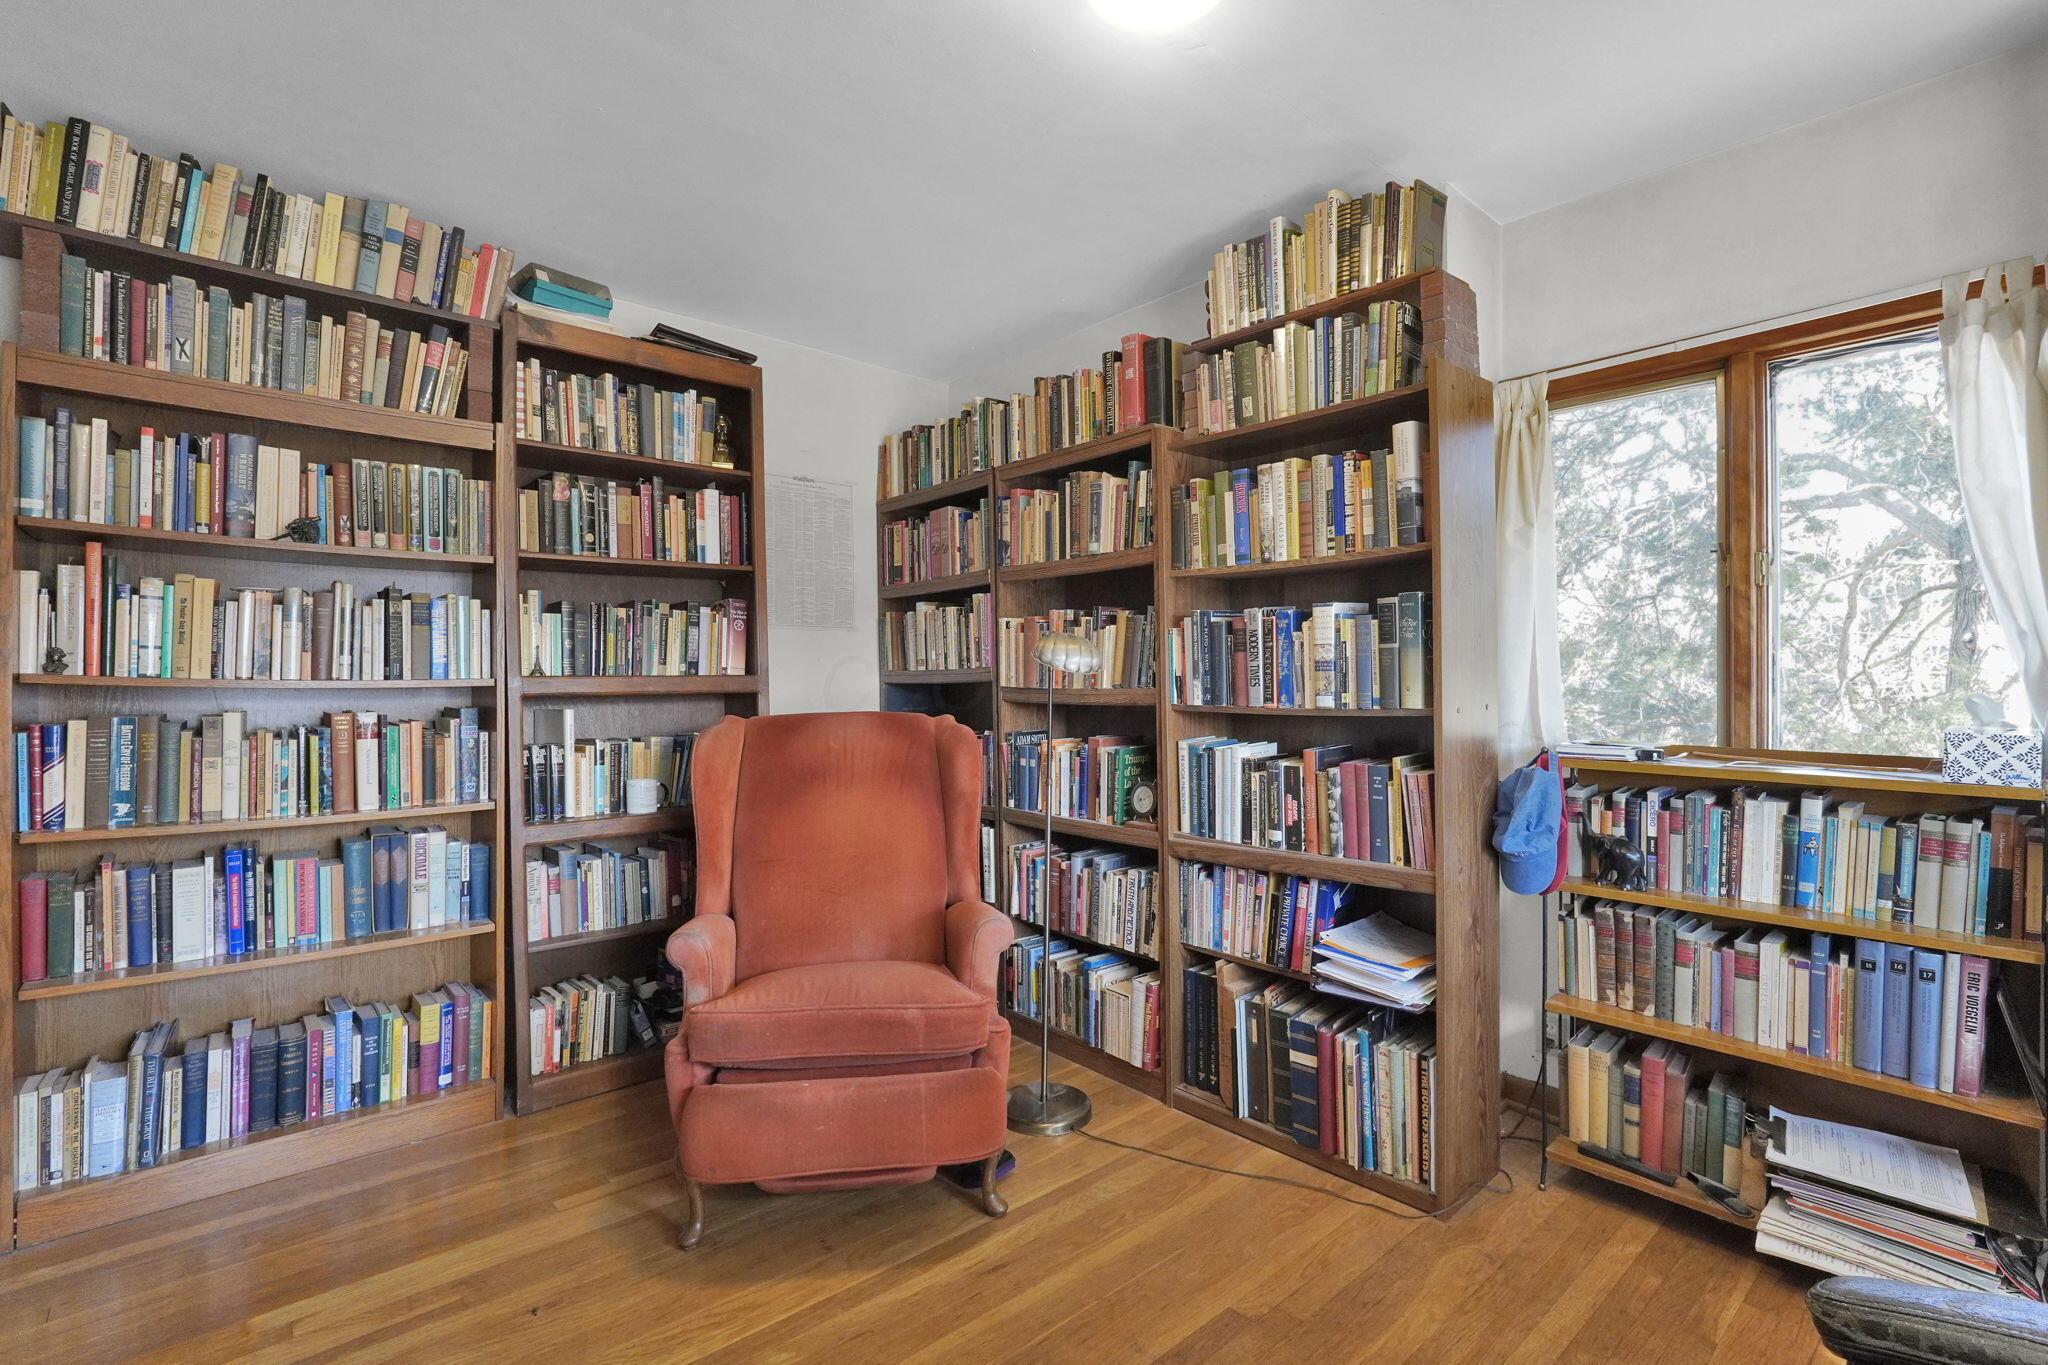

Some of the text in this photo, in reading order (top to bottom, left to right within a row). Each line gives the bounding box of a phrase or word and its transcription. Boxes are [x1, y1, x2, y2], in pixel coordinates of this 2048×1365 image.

[73, 122, 82, 136] THE
[70, 136, 80, 152] BOOK
[69, 152, 77, 160] OF
[66, 161, 75, 185] ABIGAIL
[64, 186, 73, 199] AND
[61, 198, 71, 217] JOHN
[1327, 196, 1336, 219] Ortega
[118, 278, 126, 288] The
[117, 320, 125, 333] John
[116, 334, 125, 359] Randolph
[1105, 351, 1113, 385] WINSTON
[238, 453, 247, 489] WROUGHT
[1343, 459, 1354, 504] COMMAND
[1235, 482, 1247, 514] HERESIES
[1343, 505, 1354, 514] IN
[389, 620, 399, 659] FREEDOM
[1264, 635, 1272, 646] THE
[1249, 628, 1261, 687] MODERN TIMES
[1264, 646, 1272, 664] FACE
[1265, 664, 1272, 673] OF
[120, 725, 134, 745] BATTLE
[120, 746, 133, 758] CRY
[120, 764, 133, 791] FREEDOM
[192, 762, 200, 814] AMERICAN THOUGHT
[415, 838, 428, 880] ROCKDALE
[1127, 901, 1135, 915] AND
[1281, 895, 1291, 926] PRIVATE
[1127, 915, 1135, 945] METHOD
[1277, 927, 1288, 957] CHOICE
[1304, 934, 1312, 957] ISSUES
[1922, 971, 1932, 979] 17
[1963, 972, 1981, 1035] ERIC VOEGELIN
[146, 1061, 157, 1096] THE BLUE
[1362, 1080, 1370, 1102] Natural
[144, 1107, 154, 1122] THE
[1421, 1089, 1429, 1118] BOOK
[1362, 1104, 1371, 1137] Heritage
[1422, 1119, 1429, 1132] OF
